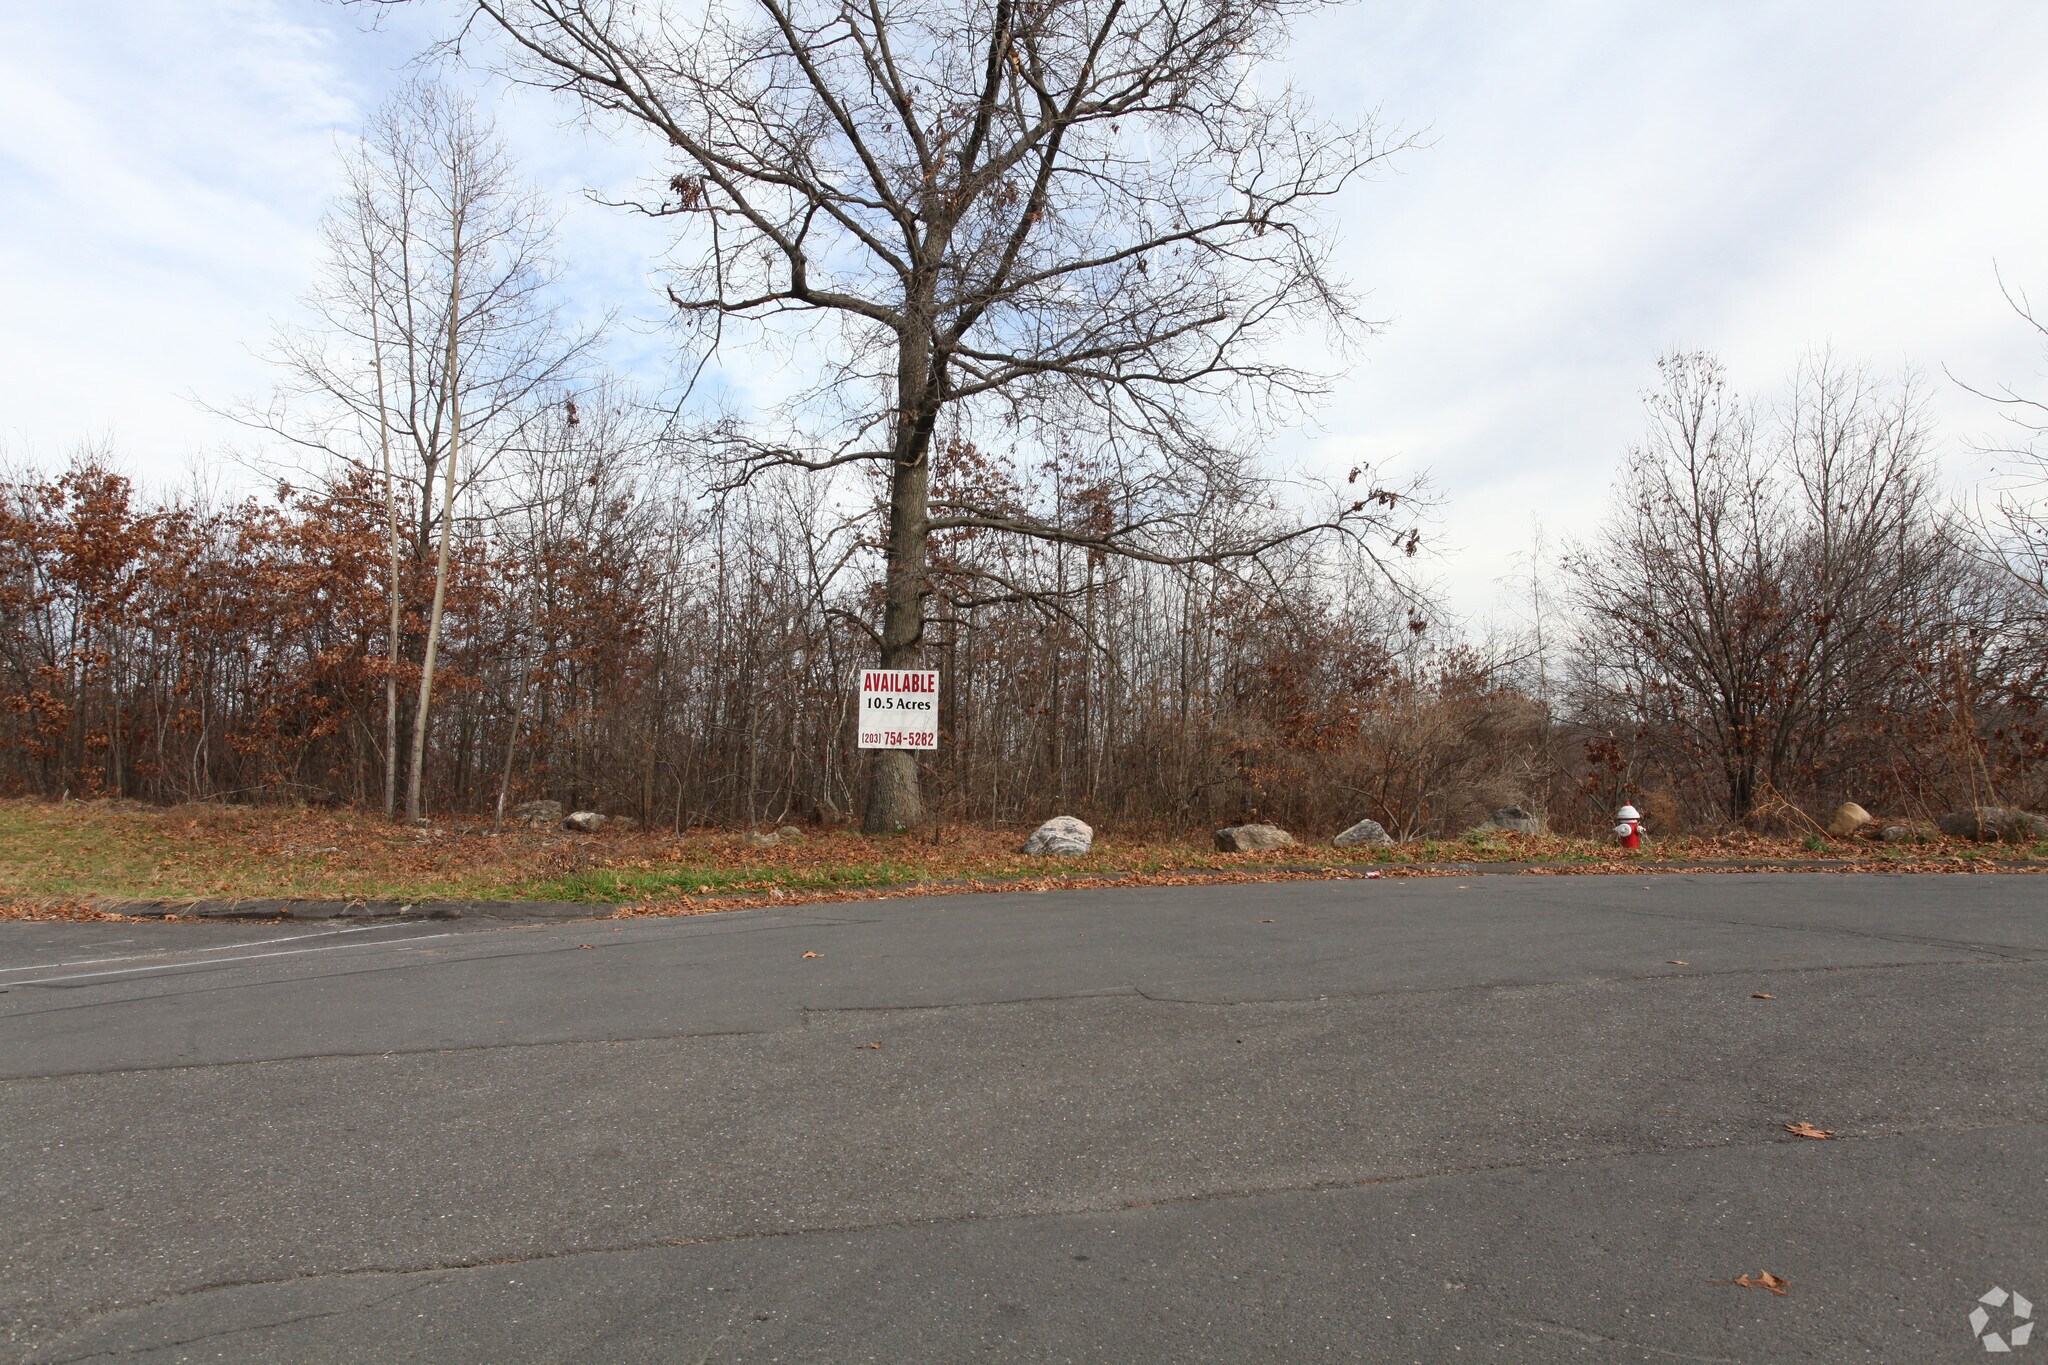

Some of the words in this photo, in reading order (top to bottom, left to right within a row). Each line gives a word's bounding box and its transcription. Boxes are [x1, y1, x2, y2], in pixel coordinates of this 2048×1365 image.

[863, 673, 935, 693] AVAILABLE
[867, 697, 893, 709] 10.5
[896, 698, 931, 710] Acres
[861, 732, 881, 744] (203)
[884, 731, 934, 747] 754-5282
